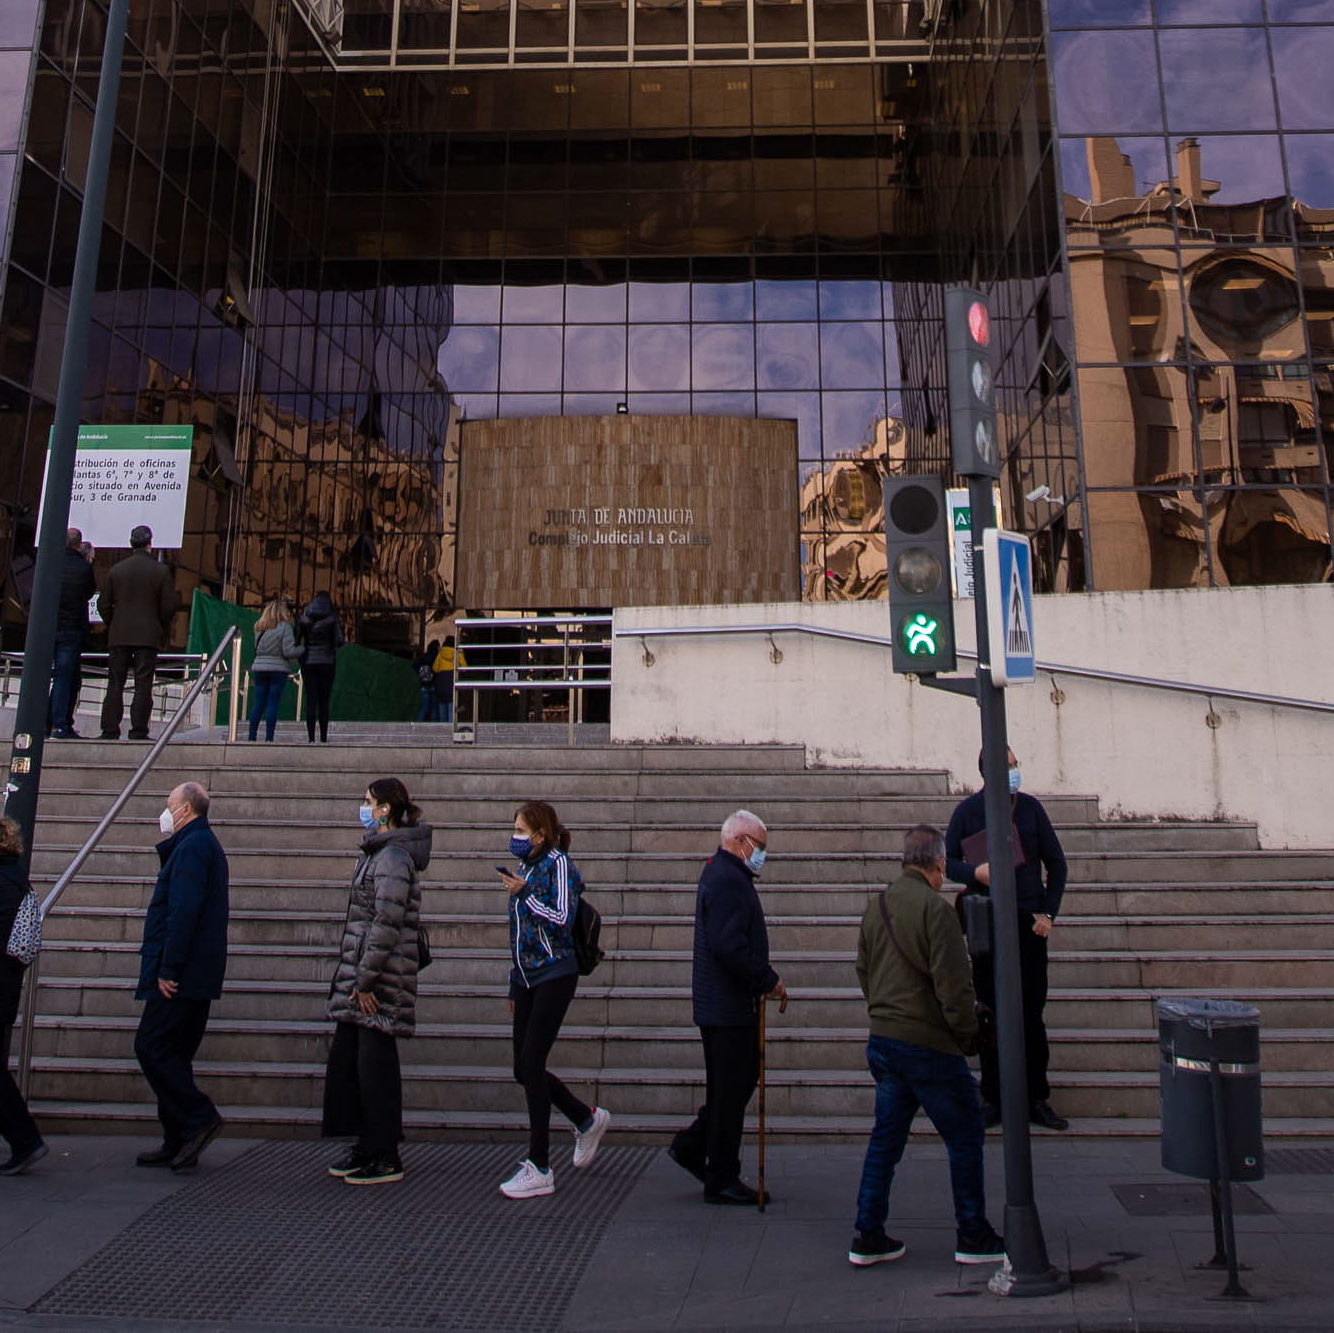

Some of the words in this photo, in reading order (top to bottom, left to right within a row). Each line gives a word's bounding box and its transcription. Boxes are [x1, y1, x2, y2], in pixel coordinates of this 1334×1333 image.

[124, 458, 134, 468] de
[140, 458, 176, 468] oficinas
[138, 472, 143, 481] y
[163, 470, 175, 479] de
[88, 481, 122, 490] situado
[144, 481, 181, 490] Avenida
[91, 493, 96, 501] 3
[101, 492, 112, 501] de
[118, 492, 157, 502] Granada
[544, 509, 586, 526] JUNTA
[595, 509, 611, 525] DE
[528, 530, 589, 547] Complejo
[592, 530, 644, 546] Judicial
[649, 530, 664, 545] La
